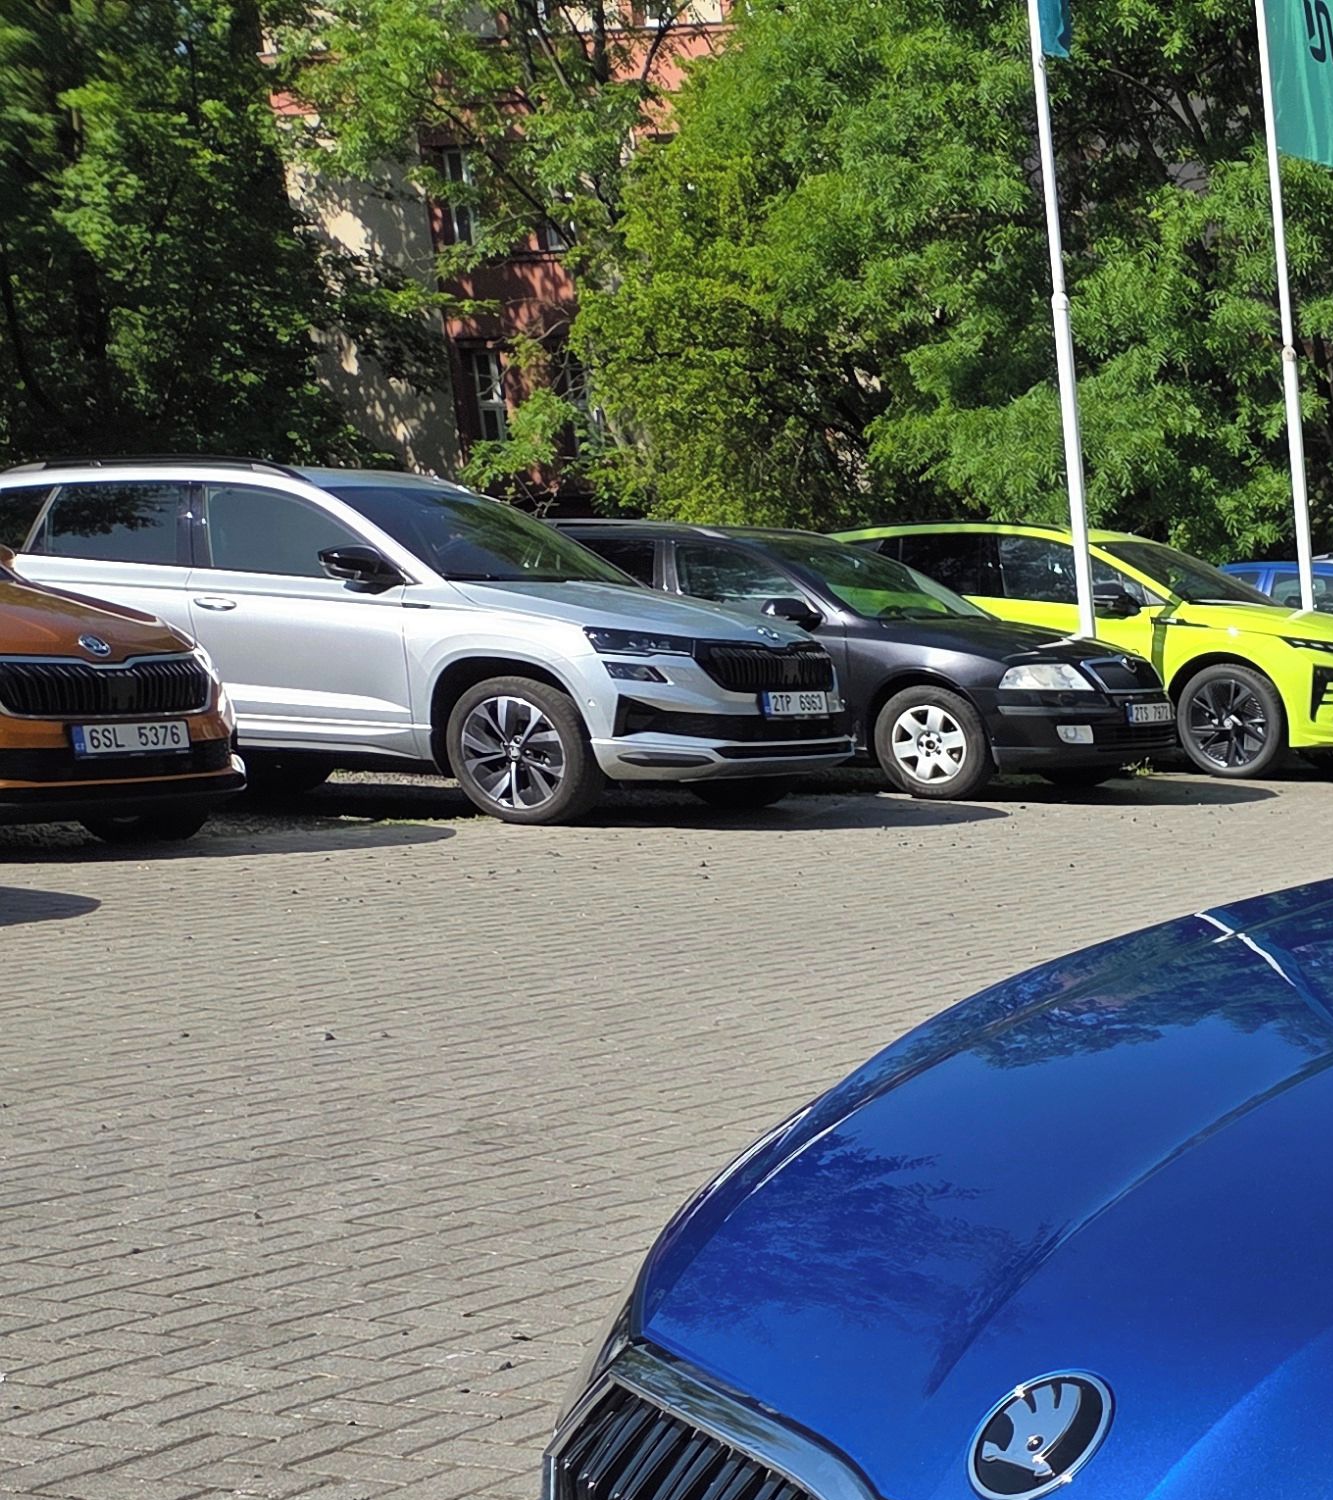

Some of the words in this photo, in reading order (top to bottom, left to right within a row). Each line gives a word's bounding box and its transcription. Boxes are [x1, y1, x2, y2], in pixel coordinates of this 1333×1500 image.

[771, 694, 792, 712] 2TP
[89, 727, 126, 750] 6SL
[137, 724, 181, 747] 5376
